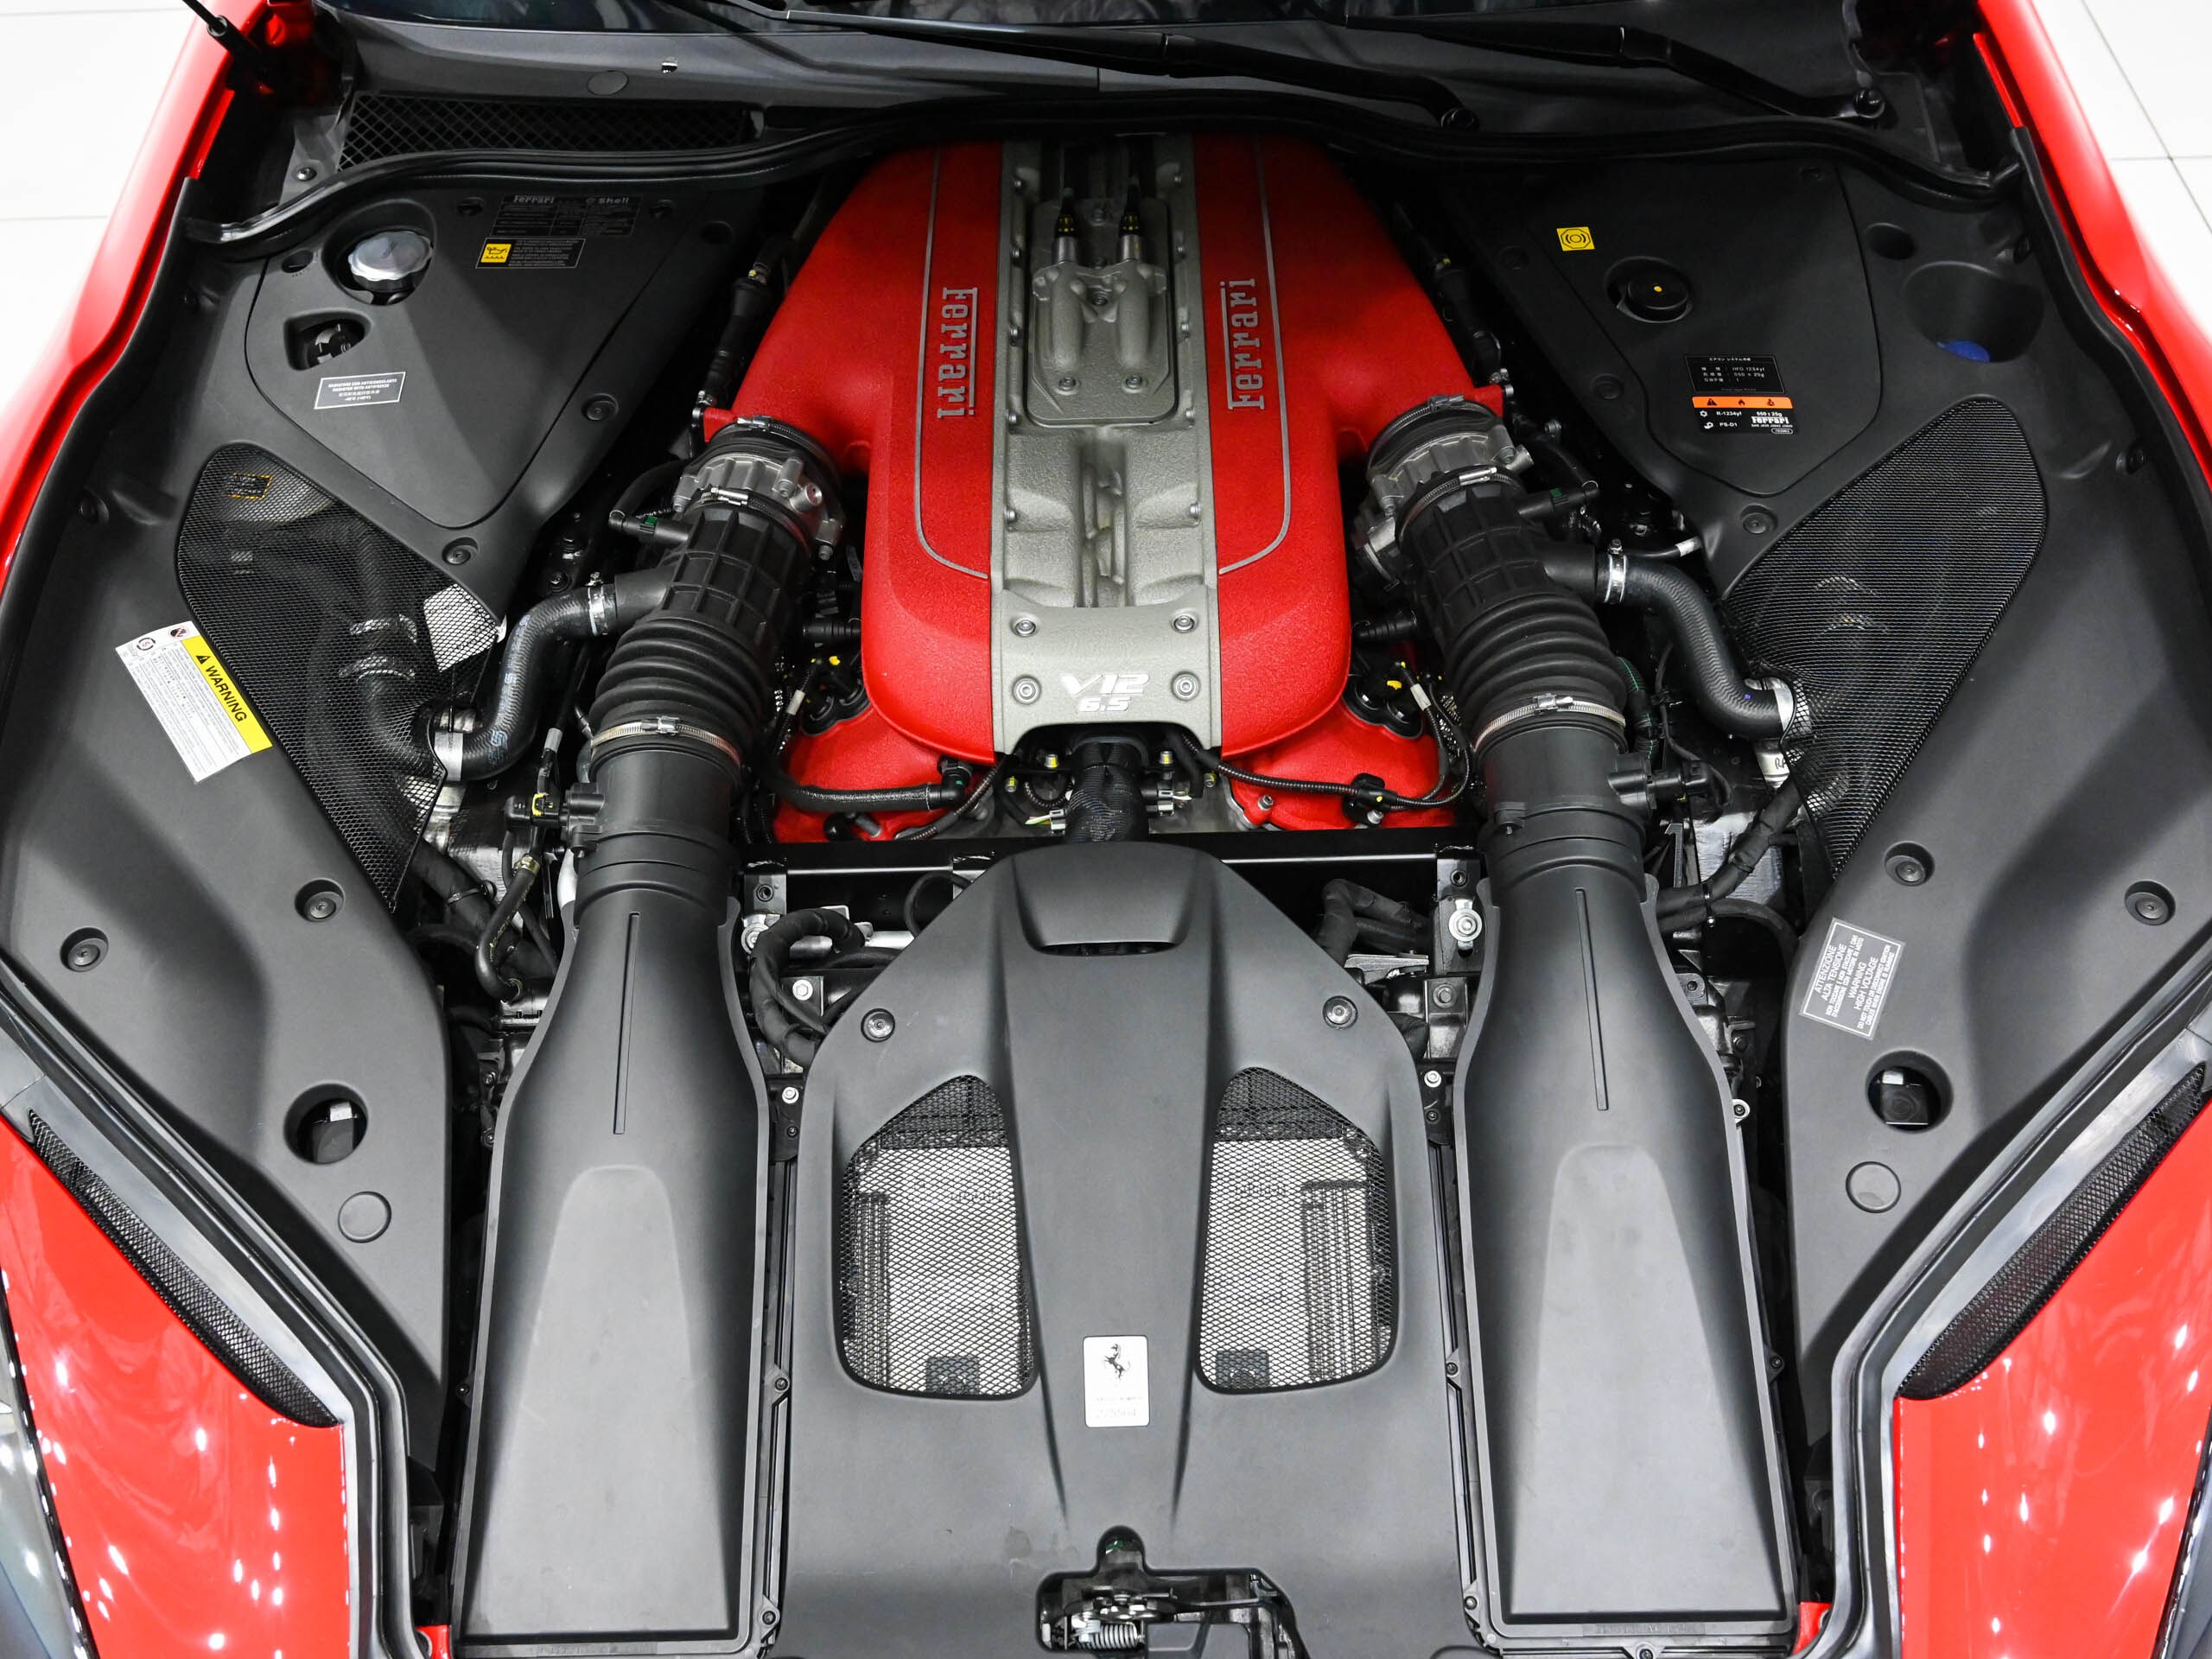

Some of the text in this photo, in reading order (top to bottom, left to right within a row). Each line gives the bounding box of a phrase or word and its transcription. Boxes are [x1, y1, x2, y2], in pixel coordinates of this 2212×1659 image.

[937, 287, 978, 418] Ferrari
[1220, 278, 1265, 410] Ferrari
[204, 665, 248, 722] WARNING
[1061, 673, 1149, 695] V12
[1078, 696, 1130, 712] 6.5
[1814, 944, 1836, 993] ATTENZIONE
[1821, 943, 1847, 1001] ALTA TENSIONE
[1847, 961, 1866, 999] WARNING
[1853, 956, 1878, 1010] HIGH VOLTAGE
